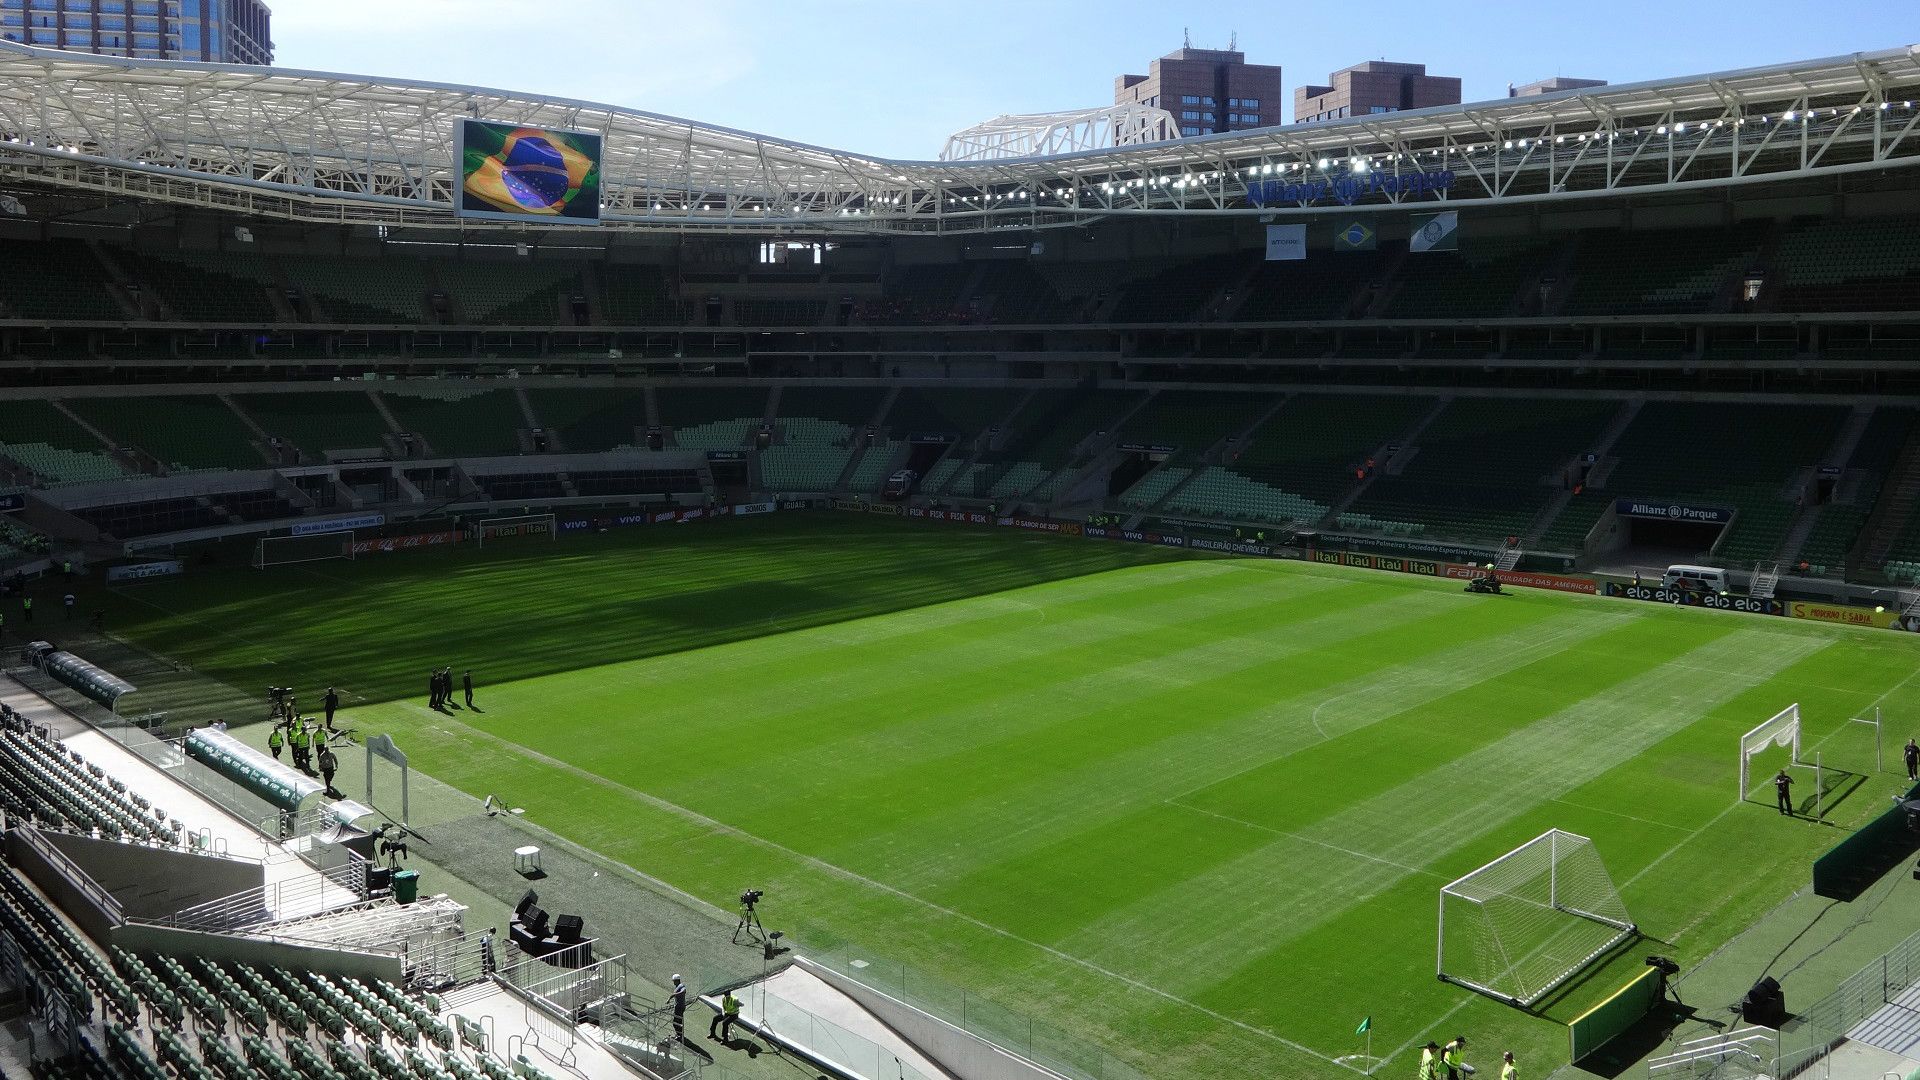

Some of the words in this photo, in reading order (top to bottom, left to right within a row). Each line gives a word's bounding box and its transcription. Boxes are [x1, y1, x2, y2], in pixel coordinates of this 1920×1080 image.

[1247, 181, 1327, 204] Allianz
[1370, 170, 1455, 198] Parque
[745, 504, 767, 513] SOMOS
[909, 508, 924, 517] FISK
[930, 510, 944, 519] FISK
[950, 512, 965, 521] FISK
[971, 514, 986, 523] FISK
[1631, 504, 1666, 515] Allianz
[1683, 508, 1718, 520] Parque
[1020, 520, 1039, 528] SABOR
[1191, 538, 1231, 551] BRASILEIRÃO
[1232, 542, 1270, 555] CHEVROLET
[1349, 537, 1375, 548] Esportiva
[1376, 540, 1406, 549] Palmeiras
[1407, 543, 1438, 552] Sociedade
[1439, 546, 1468, 556] Esportiva
[1315, 551, 1339, 563] Itaú
[1346, 554, 1370, 567] Itaú
[1377, 557, 1402, 571] Itaú
[1410, 560, 1435, 574] Itaú
[1535, 577, 1551, 587] DAS
[1627, 586, 1651, 600] elo
[1655, 588, 1680, 603] elo
[1704, 595, 1730, 609] elo
[1735, 598, 1762, 613] elo
[1810, 607, 1840, 620] MODERNO
